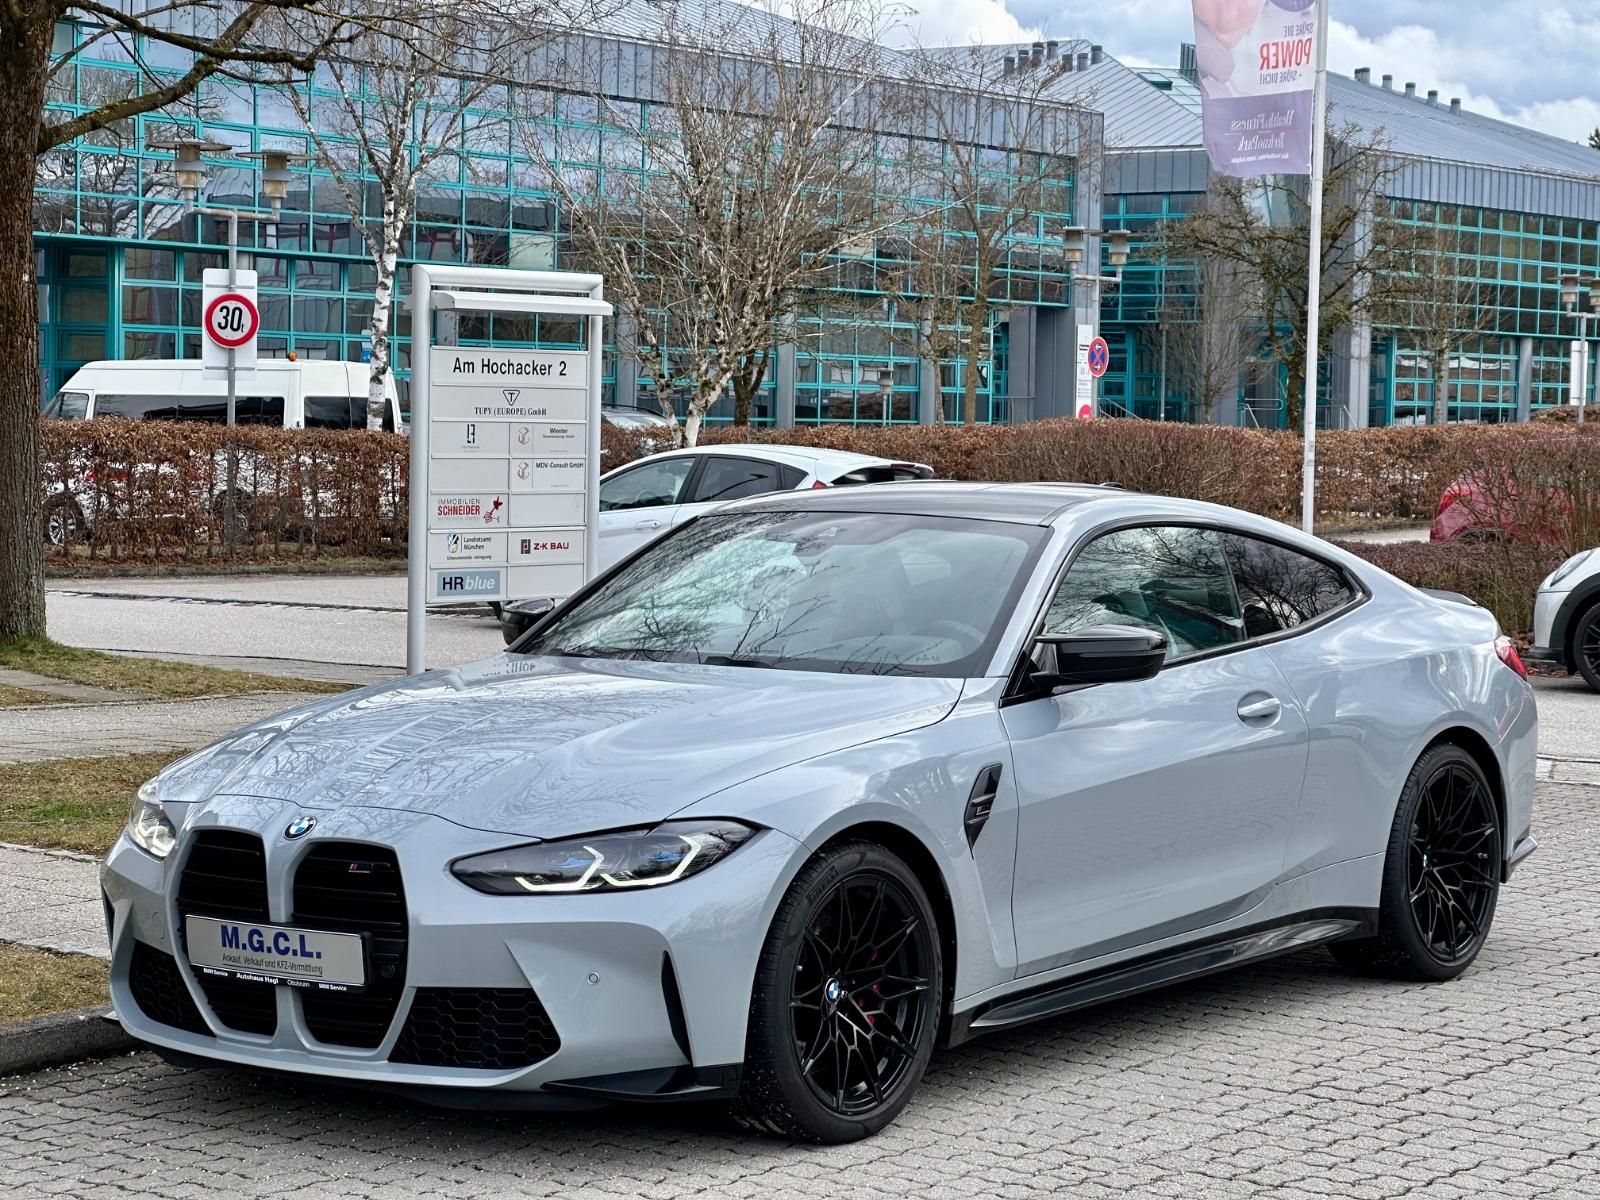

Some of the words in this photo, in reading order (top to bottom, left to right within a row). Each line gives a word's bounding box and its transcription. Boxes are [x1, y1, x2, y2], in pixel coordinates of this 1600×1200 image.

[218, 305, 242, 331] 30
[453, 357, 475, 374] Am
[481, 358, 553, 376] Hochacker
[559, 361, 567, 376] 2
[474, 407, 492, 415] TUPY
[493, 407, 527, 416] (EUROPE)
[528, 408, 547, 416] GmbH
[437, 505, 480, 516] SCHNEIDER
[221, 925, 322, 959] M.G.C.L.
[243, 955, 264, 966] Verkauf
[264, 959, 275, 968] und
[277, 961, 322, 975] KFZ-Vermittlung
[236, 972, 263, 982] Autohaus
